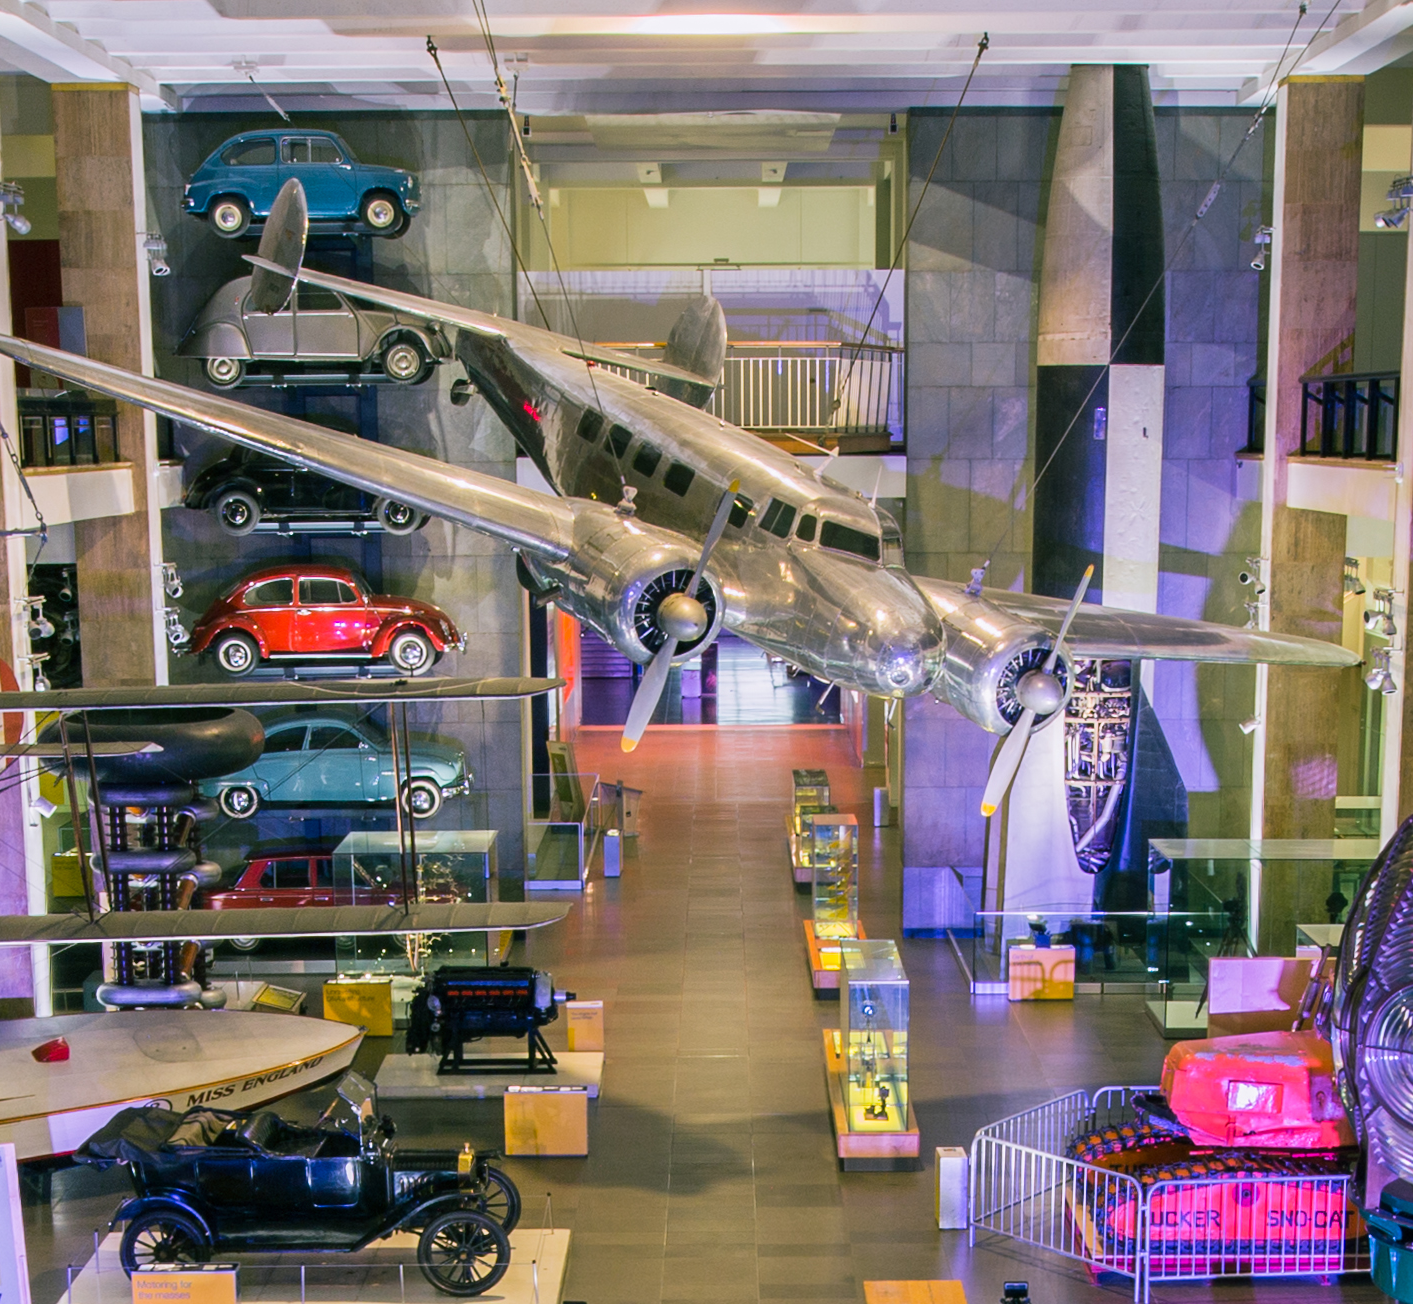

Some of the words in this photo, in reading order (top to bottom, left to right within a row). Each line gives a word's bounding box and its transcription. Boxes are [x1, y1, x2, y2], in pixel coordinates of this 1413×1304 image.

[186, 1084, 236, 1108] MISS
[241, 1056, 324, 1092] ENGLAND
[1267, 1210, 1355, 1229] SNO-CAT
[136, 1281, 178, 1291] Motoring
[180, 1280, 193, 1289] for
